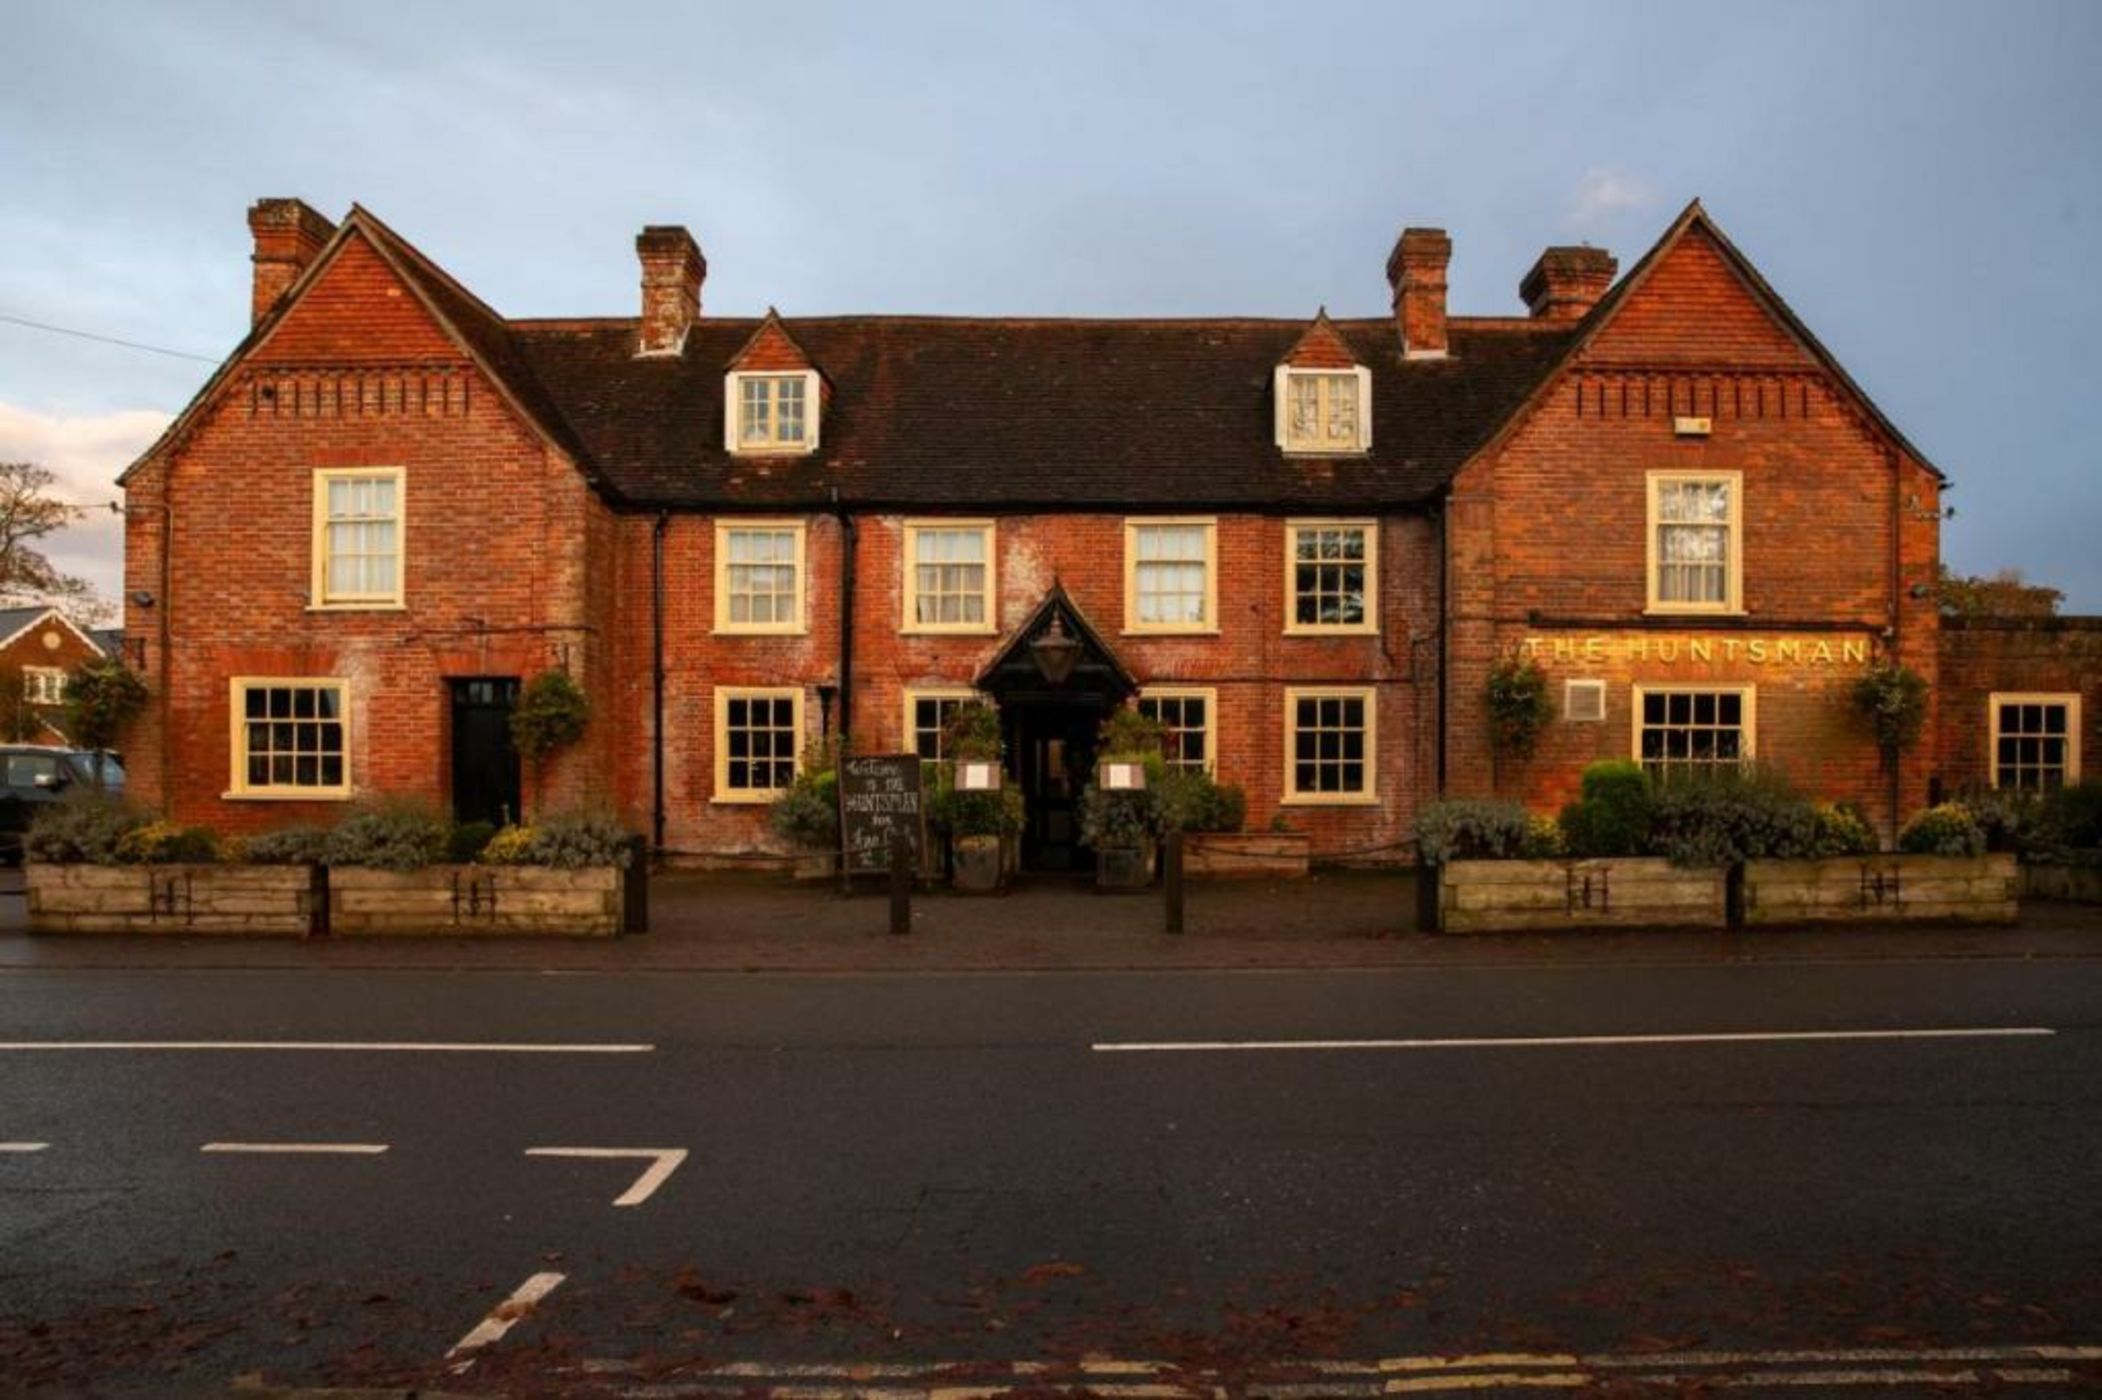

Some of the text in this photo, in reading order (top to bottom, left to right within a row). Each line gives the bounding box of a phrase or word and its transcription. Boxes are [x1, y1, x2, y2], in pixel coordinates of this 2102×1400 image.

[1525, 638, 1865, 662] THE HUNTSMAN
[845, 791, 918, 812] HUNTSMAN
